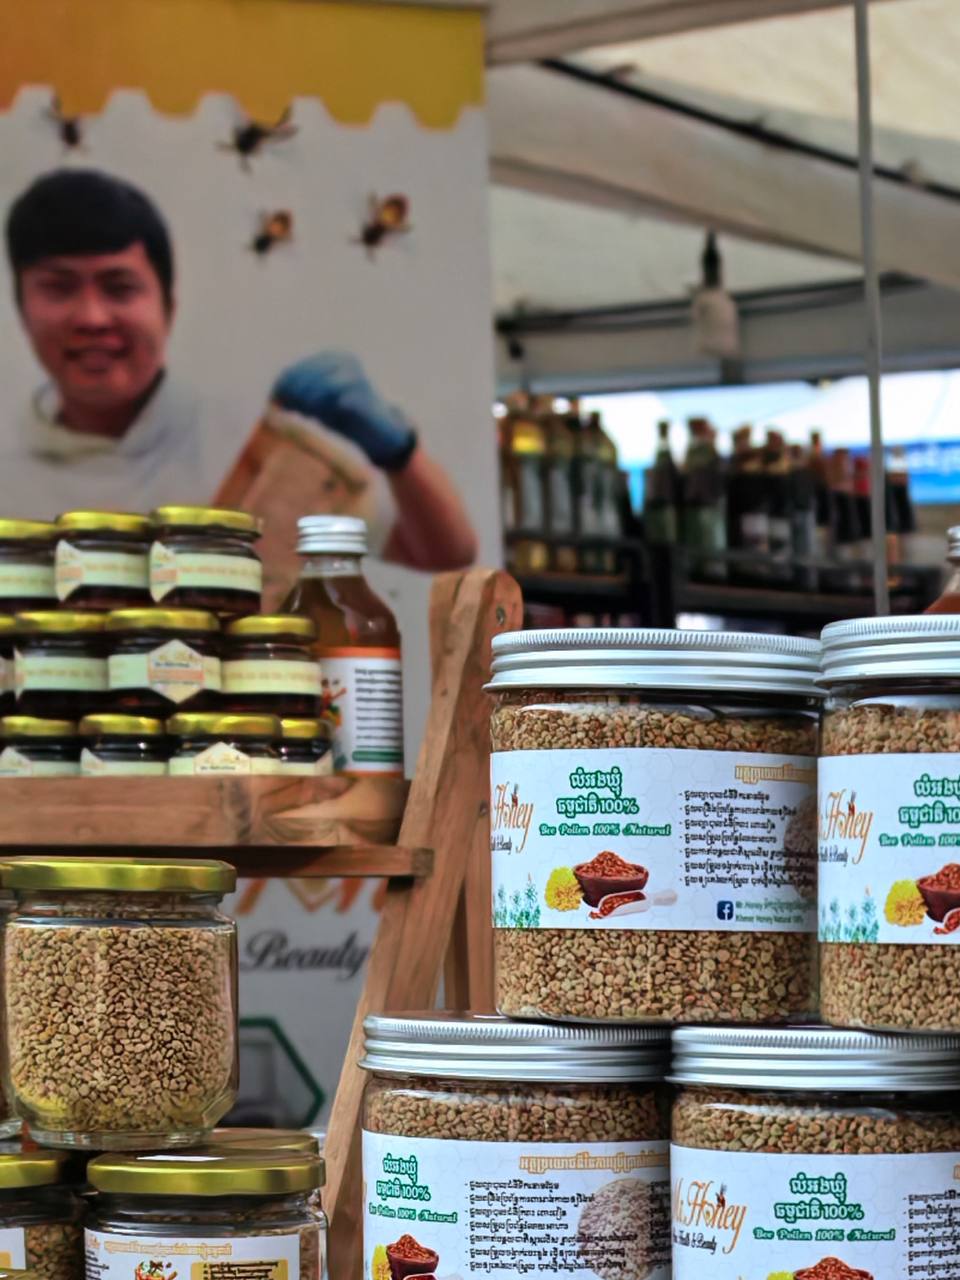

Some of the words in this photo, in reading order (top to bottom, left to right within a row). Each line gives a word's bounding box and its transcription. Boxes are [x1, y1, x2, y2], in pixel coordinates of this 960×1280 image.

[600, 799, 640, 816] 100%
[539, 823, 557, 836] Bee
[560, 823, 590, 836] Pollen
[593, 823, 620, 836] 100%
[622, 823, 671, 836] Natural
[824, 789, 873, 864] Honey
[879, 834, 899, 847] Bee
[902, 834, 935, 847] Pollen
[240, 929, 369, 981] Beauty
[401, 1185, 431, 1202] 100%
[418, 1209, 458, 1224] Natural
[684, 1180, 747, 1255] Honey
[823, 1203, 864, 1220] 100%
[754, 1228, 774, 1241] Bee
[777, 1228, 812, 1241] Pollen
[815, 1228, 845, 1241] 100%
[847, 1228, 895, 1241] Natural
